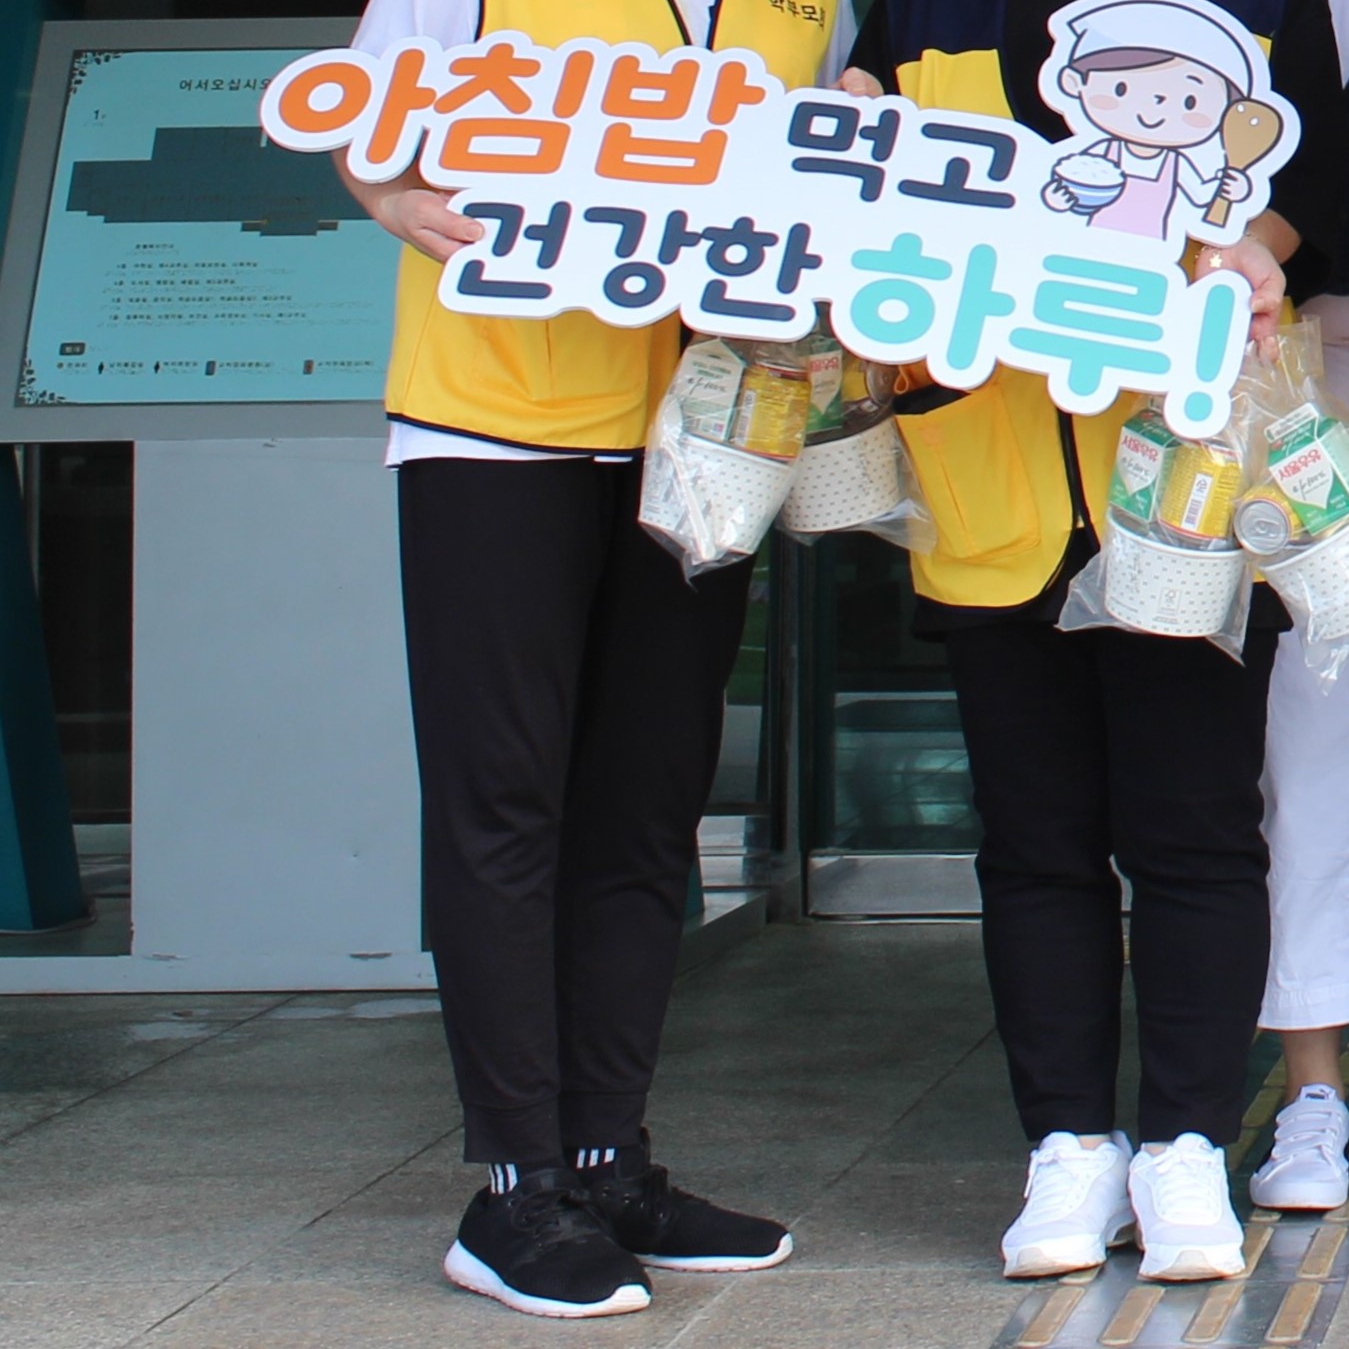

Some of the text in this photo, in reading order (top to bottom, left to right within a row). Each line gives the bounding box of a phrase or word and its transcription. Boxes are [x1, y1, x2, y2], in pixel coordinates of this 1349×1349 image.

[179, 78, 271, 91] 어서오십시오
[278, 42, 1017, 209] 아침밥 먹고
[456, 200, 823, 323] 건강한
[850, 232, 1236, 422] 하루!
